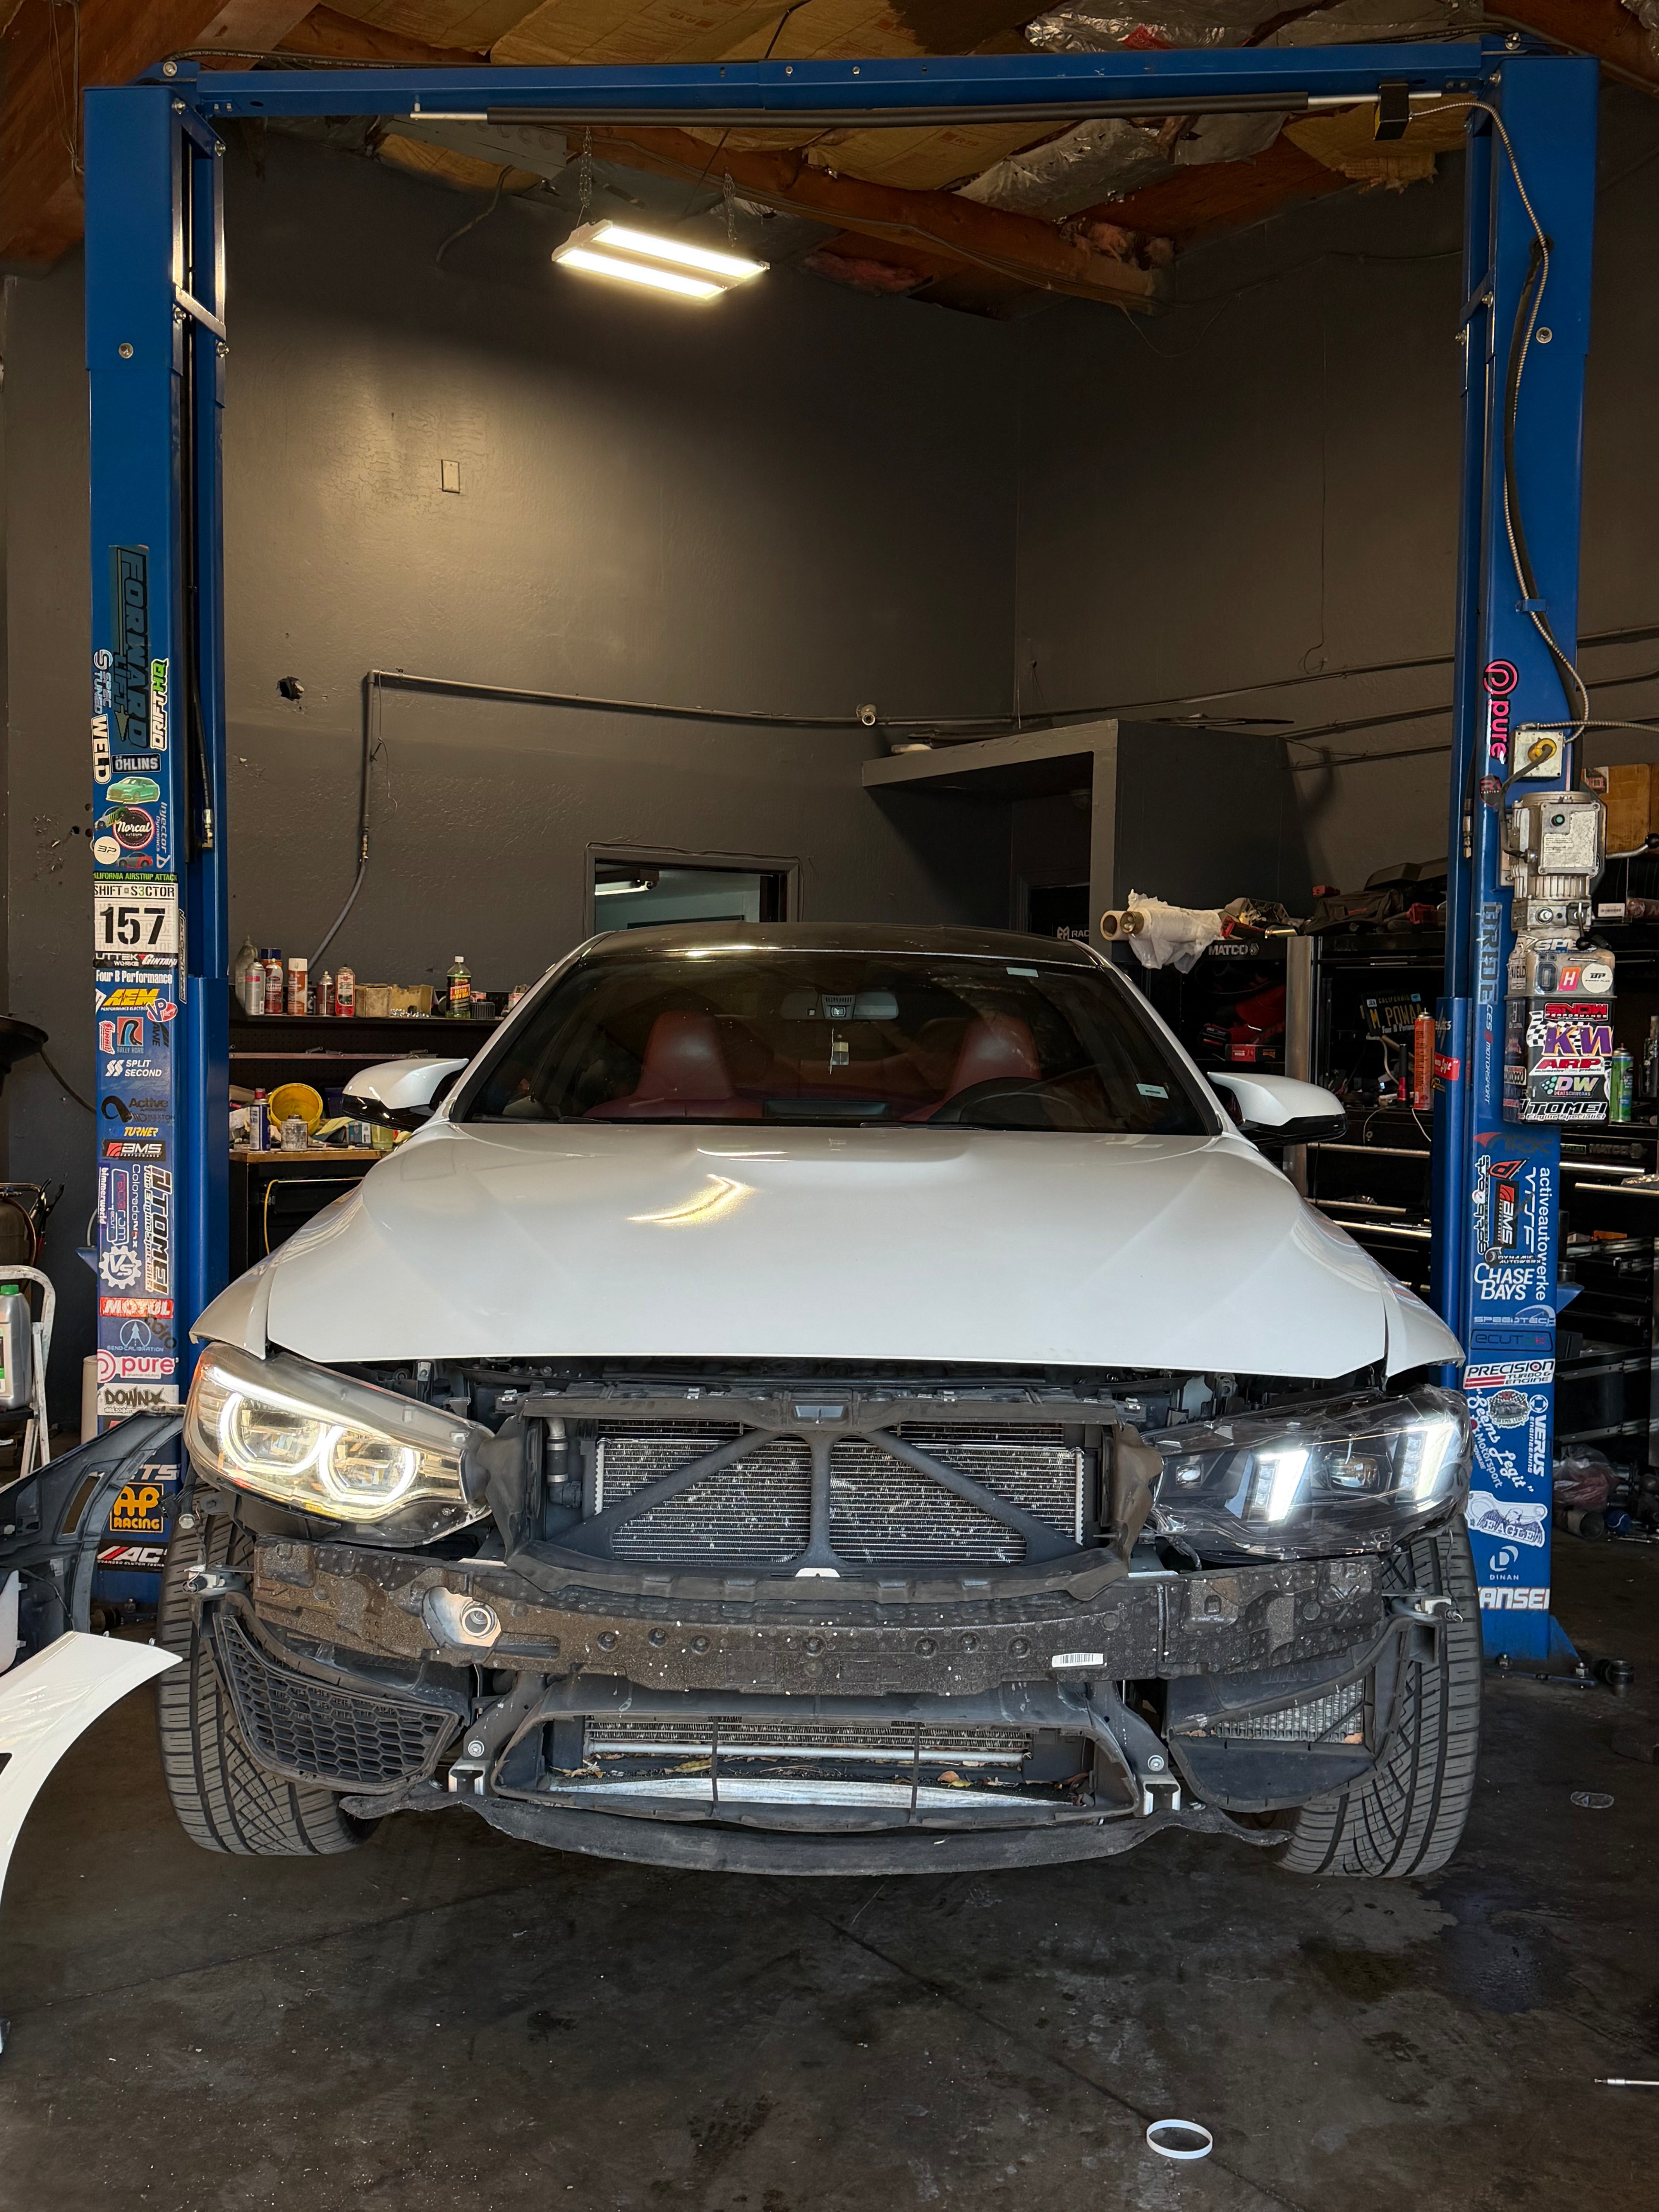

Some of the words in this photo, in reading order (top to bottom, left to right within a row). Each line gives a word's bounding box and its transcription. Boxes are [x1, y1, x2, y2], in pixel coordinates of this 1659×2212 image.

[120, 549, 149, 749] FORWARD
[94, 671, 103, 714] TUNED
[103, 672, 112, 708] SPEC
[1491, 700, 1509, 759] pure
[93, 716, 110, 783] WELD
[115, 756, 158, 771] ÖHLINS
[117, 820, 153, 833] Norcal
[160, 802, 168, 854] Injector
[94, 885, 123, 895] SHIFT
[131, 886, 175, 897] S3CTOR
[100, 906, 166, 945] 157
[1208, 944, 1249, 956] MATCO
[96, 969, 113, 982] Four
[122, 970, 173, 984] Performance
[102, 988, 160, 1006] AEM
[1370, 1008, 1381, 1029] M
[124, 1069, 162, 1077] SECOND
[126, 1060, 151, 1068] SPLIT
[1535, 1058, 1602, 1069] ARP
[124, 1127, 159, 1137] TURNER
[99, 1167, 109, 1225] bimmerworld
[1535, 1168, 1553, 1301] activeautowerke
[1474, 1262, 1535, 1285] CHASE
[1480, 1279, 1527, 1301] BAYS
[104, 1299, 170, 1316] MOTUL
[122, 1357, 174, 1376] pure
[1532, 1414, 1547, 1477] VERUS
[113, 1486, 160, 1517] AP
[113, 1517, 160, 1530] RACING
[1483, 1518, 1535, 1542] EAGLE
[1478, 1588, 1550, 1610] ANSEI
